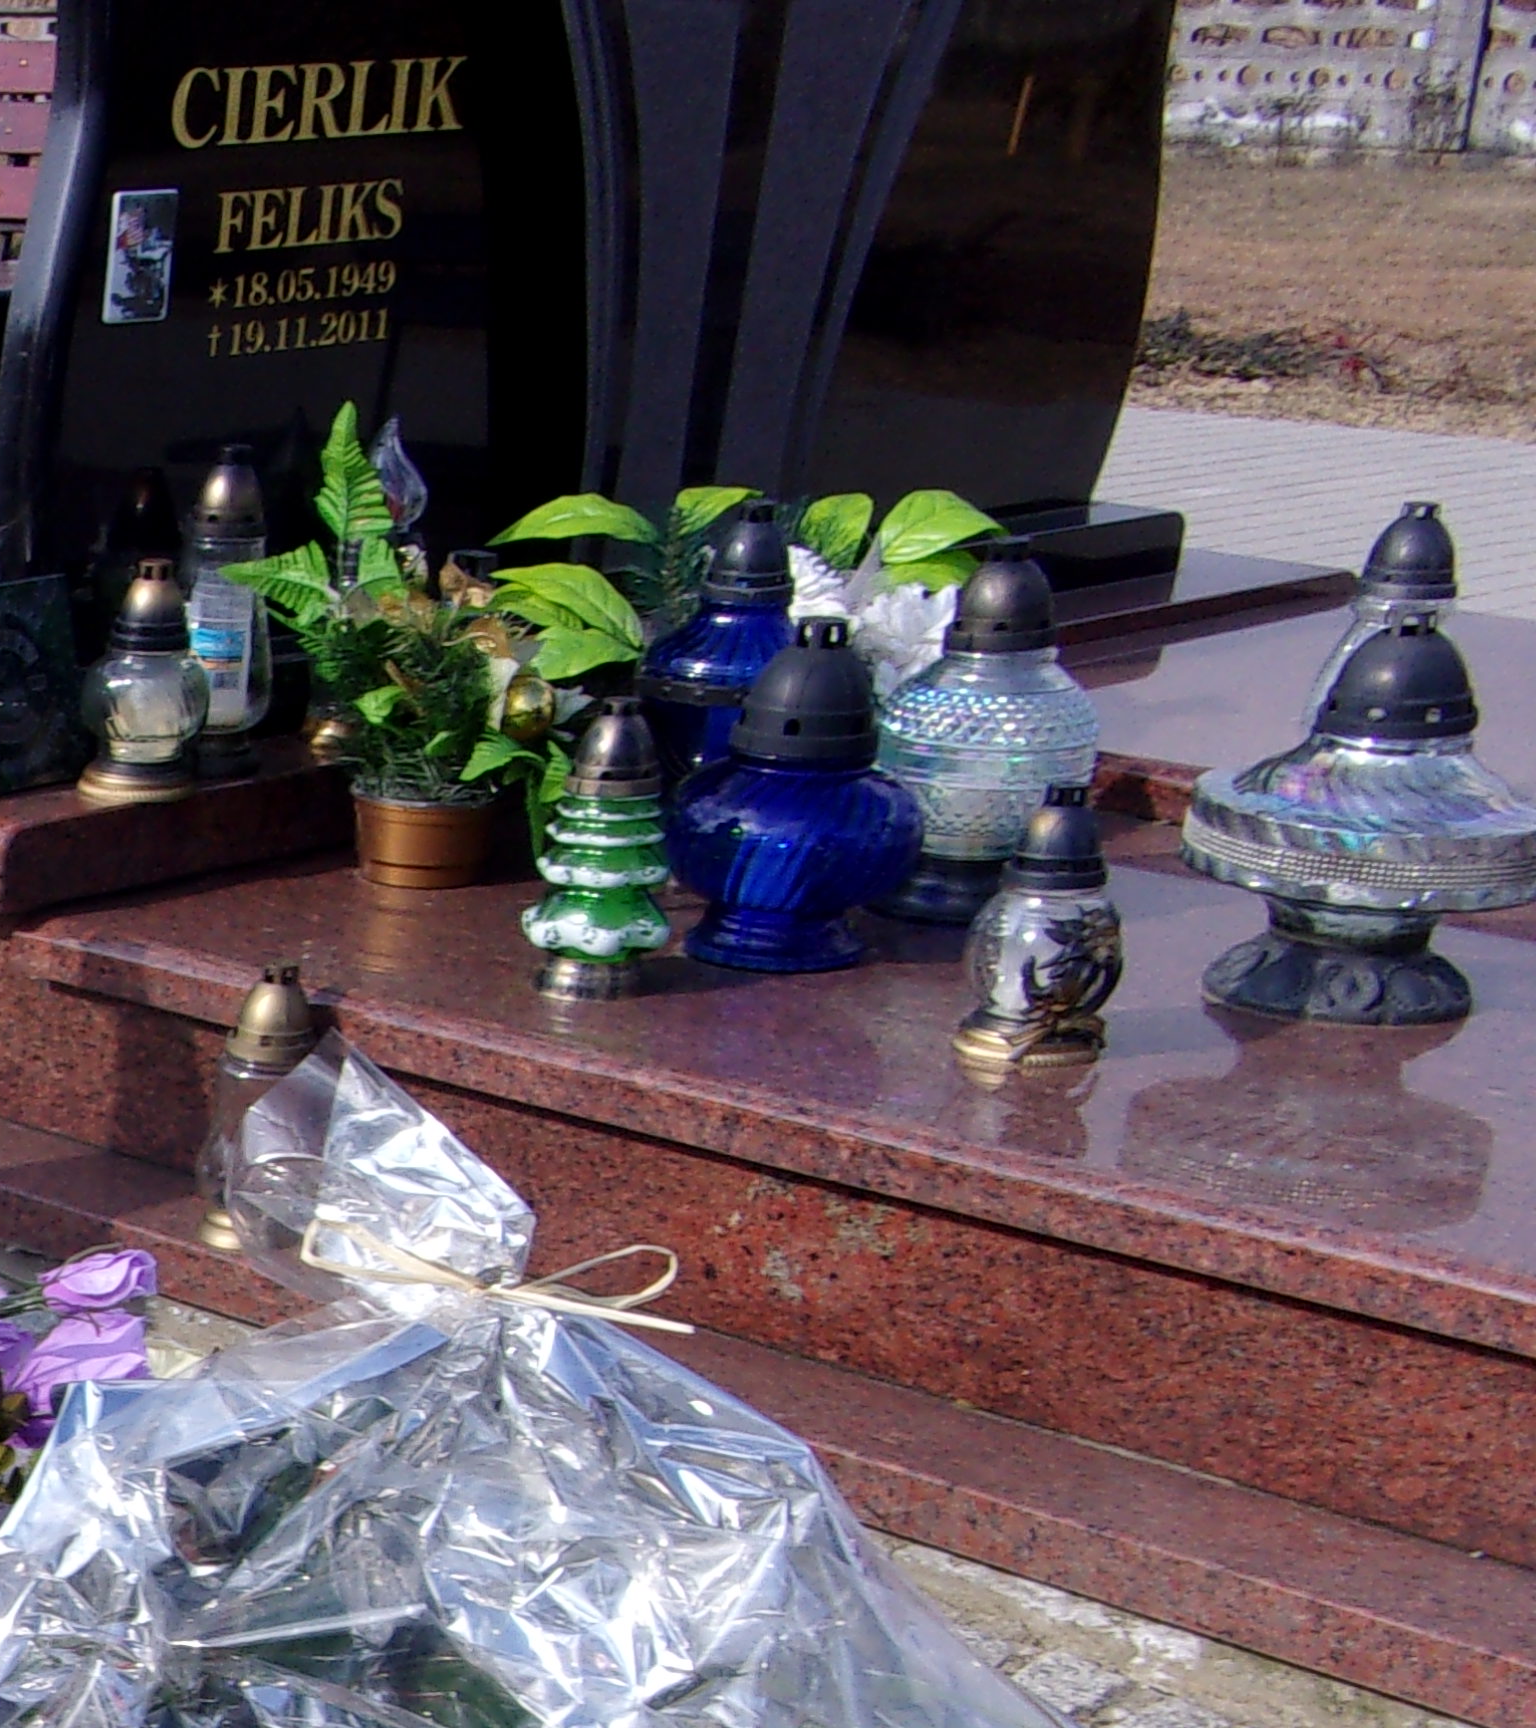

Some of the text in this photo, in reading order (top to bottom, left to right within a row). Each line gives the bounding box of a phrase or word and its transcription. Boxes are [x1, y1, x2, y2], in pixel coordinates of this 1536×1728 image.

[171, 55, 469, 150] CIERLIK
[213, 178, 405, 255] FELIKS
[232, 259, 397, 310] 18.05.1949
[229, 308, 390, 358] 19.11.2011
